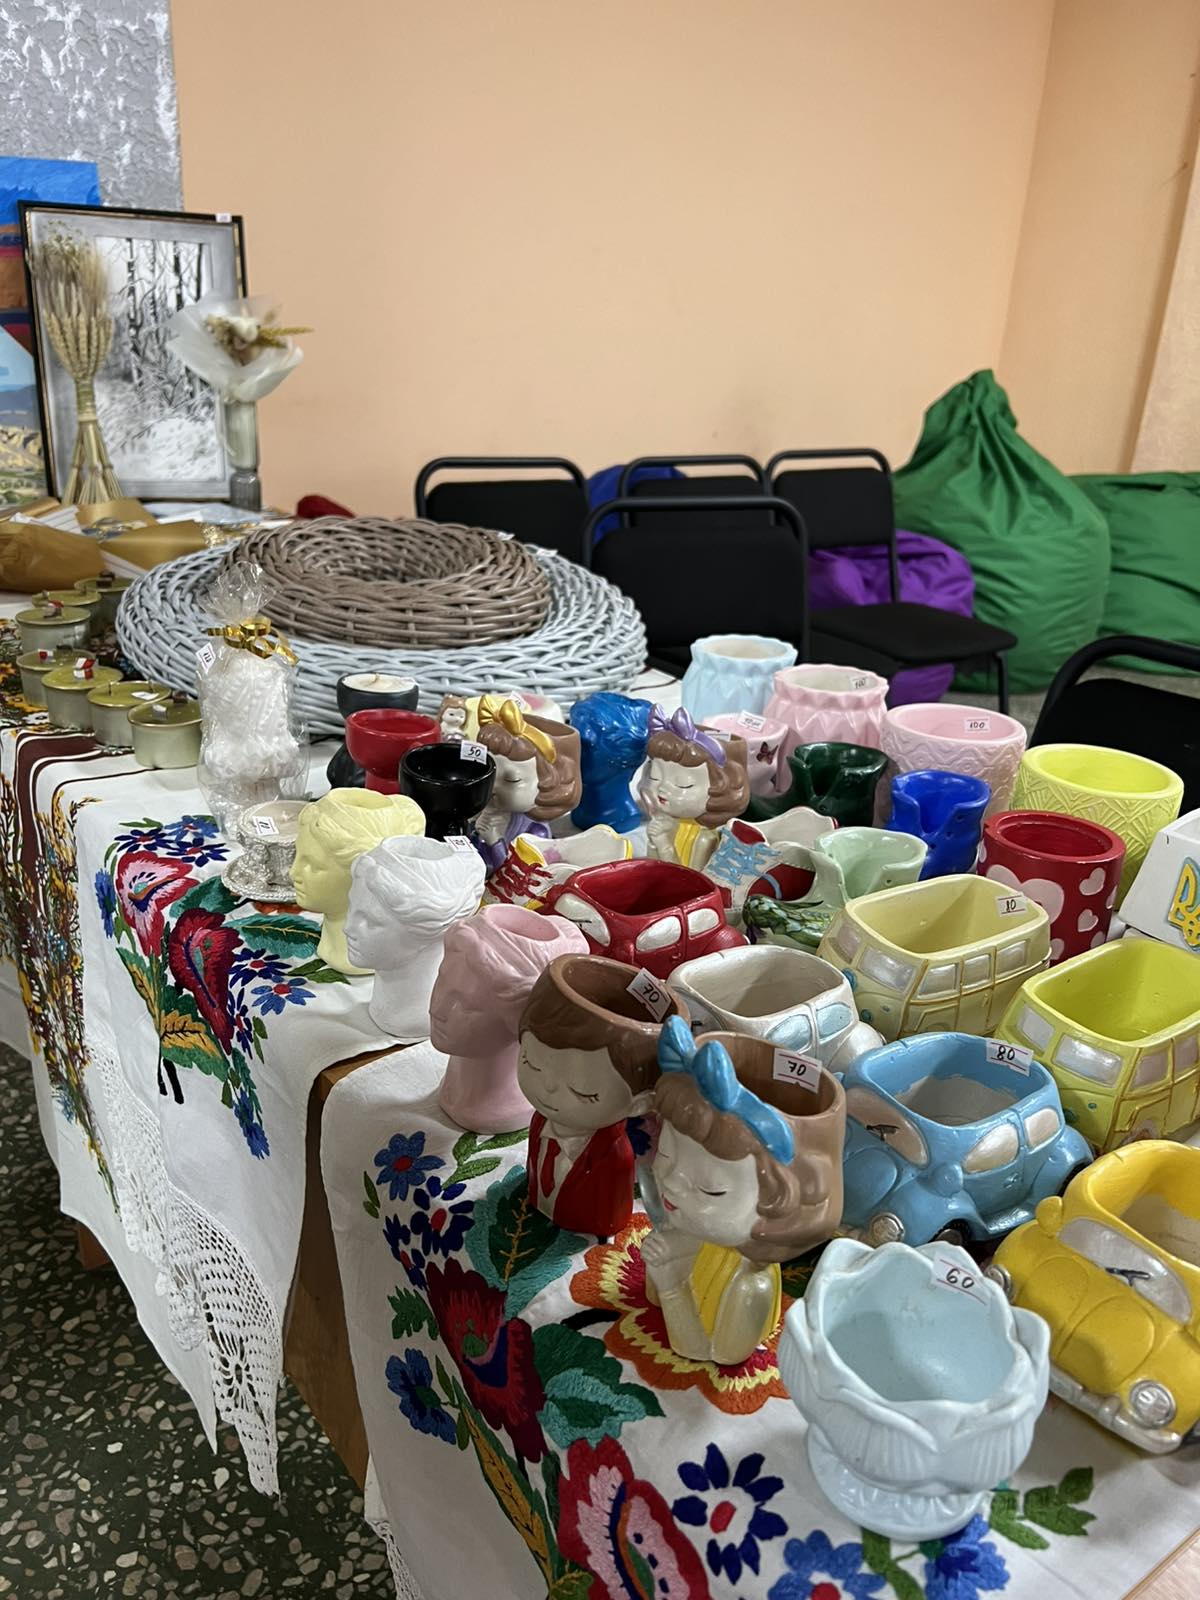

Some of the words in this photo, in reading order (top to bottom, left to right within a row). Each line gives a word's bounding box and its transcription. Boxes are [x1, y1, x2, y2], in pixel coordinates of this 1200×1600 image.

[969, 722, 985, 730] 100
[467, 746, 481, 757] 50
[642, 983, 660, 1003] 70
[996, 1045, 1016, 1062] 80
[787, 1059, 807, 1077] 70
[945, 1267, 975, 1290] 60
